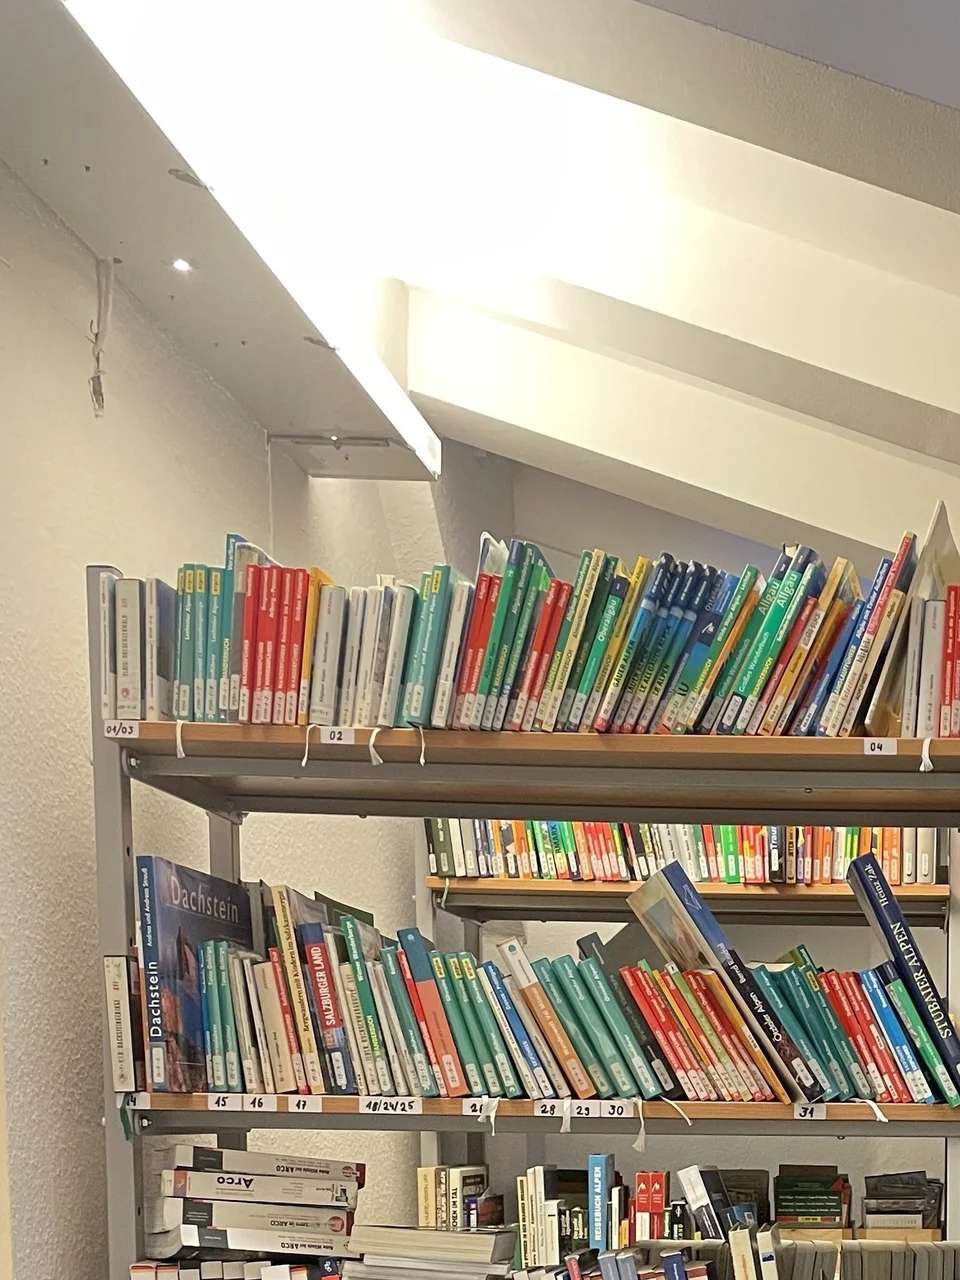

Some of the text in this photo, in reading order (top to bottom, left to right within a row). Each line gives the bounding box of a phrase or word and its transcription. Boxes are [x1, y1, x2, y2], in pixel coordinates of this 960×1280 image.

[758, 581, 780, 615] Allgäu
[776, 571, 797, 608] Allgäu
[598, 600, 617, 642] Oberallgäu
[624, 639, 636, 663] ALPEN
[739, 632, 769, 693] Großes Wanderbuch
[657, 663, 671, 687] ALPEN
[330, 731, 342, 741] 02
[870, 742, 883, 751] 04
[170, 876, 239, 923] Dachstein
[864, 864, 953, 1039] STUBAIER ALPEN Heinz Zak
[434, 959, 443, 977] alpin
[452, 959, 461, 978] alpin
[463, 959, 474, 978] alpin
[311, 946, 336, 1026] SALZBURGER LAND
[148, 961, 162, 1037] Dachstein
[730, 964, 782, 1042] Ötztaler Alpen Bernd
[297, 990, 309, 1032] Bergwandern
[215, 1096, 228, 1107] 15
[250, 1097, 263, 1108] 16
[295, 1099, 307, 1110] 17
[366, 1100, 415, 1111] 18/24/25
[540, 1104, 555, 1115] 28
[576, 1106, 590, 1116] 29
[608, 1105, 623, 1115] 30
[799, 1106, 814, 1118] 31
[276, 1165, 295, 1173] ARCO
[216, 1176, 254, 1189] Arco
